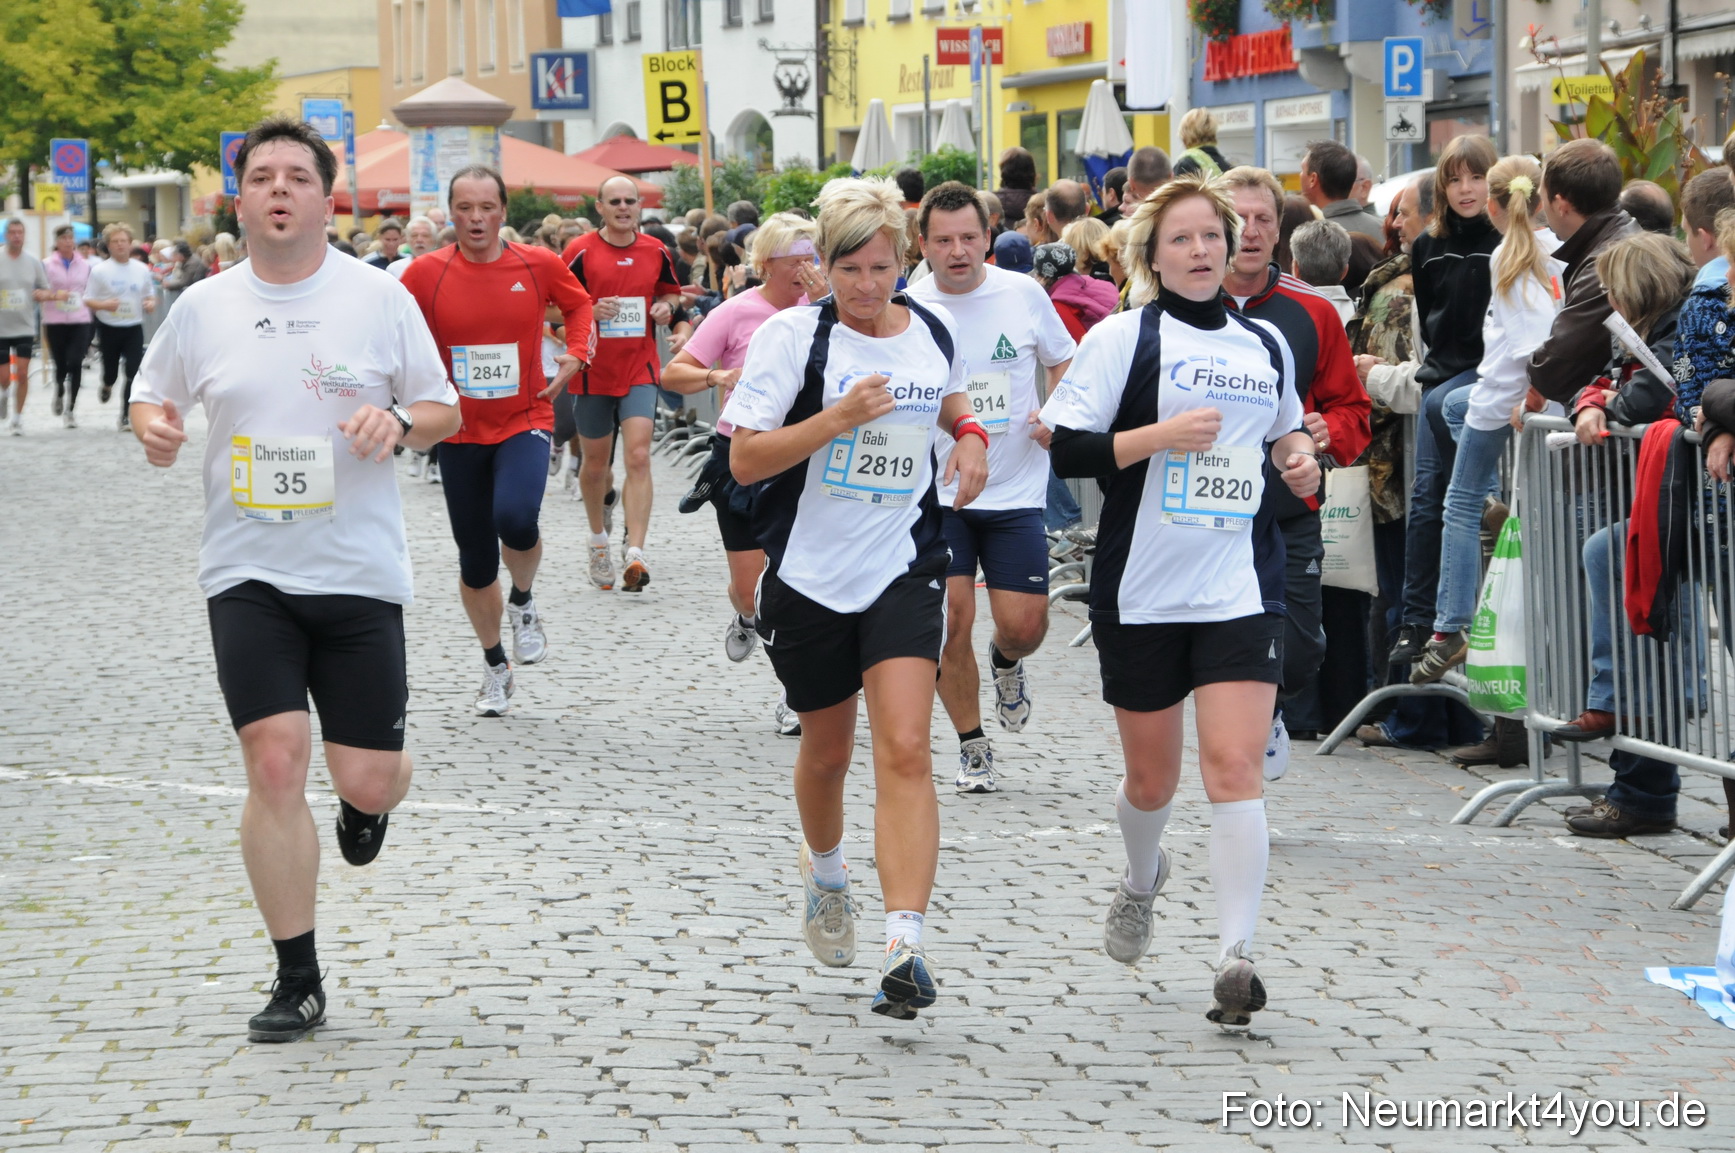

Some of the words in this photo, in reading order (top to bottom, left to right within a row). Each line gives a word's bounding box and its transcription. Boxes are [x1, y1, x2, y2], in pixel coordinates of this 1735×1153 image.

[940, 39, 1000, 53] WISSACH
[649, 55, 696, 73] Block
[1392, 45, 1415, 91] P
[659, 80, 691, 124] B
[613, 312, 641, 323] 2950
[470, 351, 501, 360] Thomas
[473, 365, 511, 380] 2847
[320, 380, 365, 389] Weltkulturerbe
[967, 380, 989, 391] alter
[1193, 369, 1273, 395] Fischer
[325, 385, 338, 394] Lauf
[338, 388, 357, 397] 2003
[1205, 389, 1274, 409] Automobile
[862, 430, 888, 446] Gabi
[255, 444, 316, 461] Christian
[835, 449, 843, 460] C
[1196, 451, 1230, 468] Petra
[857, 454, 914, 478] 2819
[273, 472, 307, 494] 35
[1171, 472, 1178, 484] C
[1194, 476, 1253, 501] 2820
[293, 505, 333, 517] PFLEIDERER
